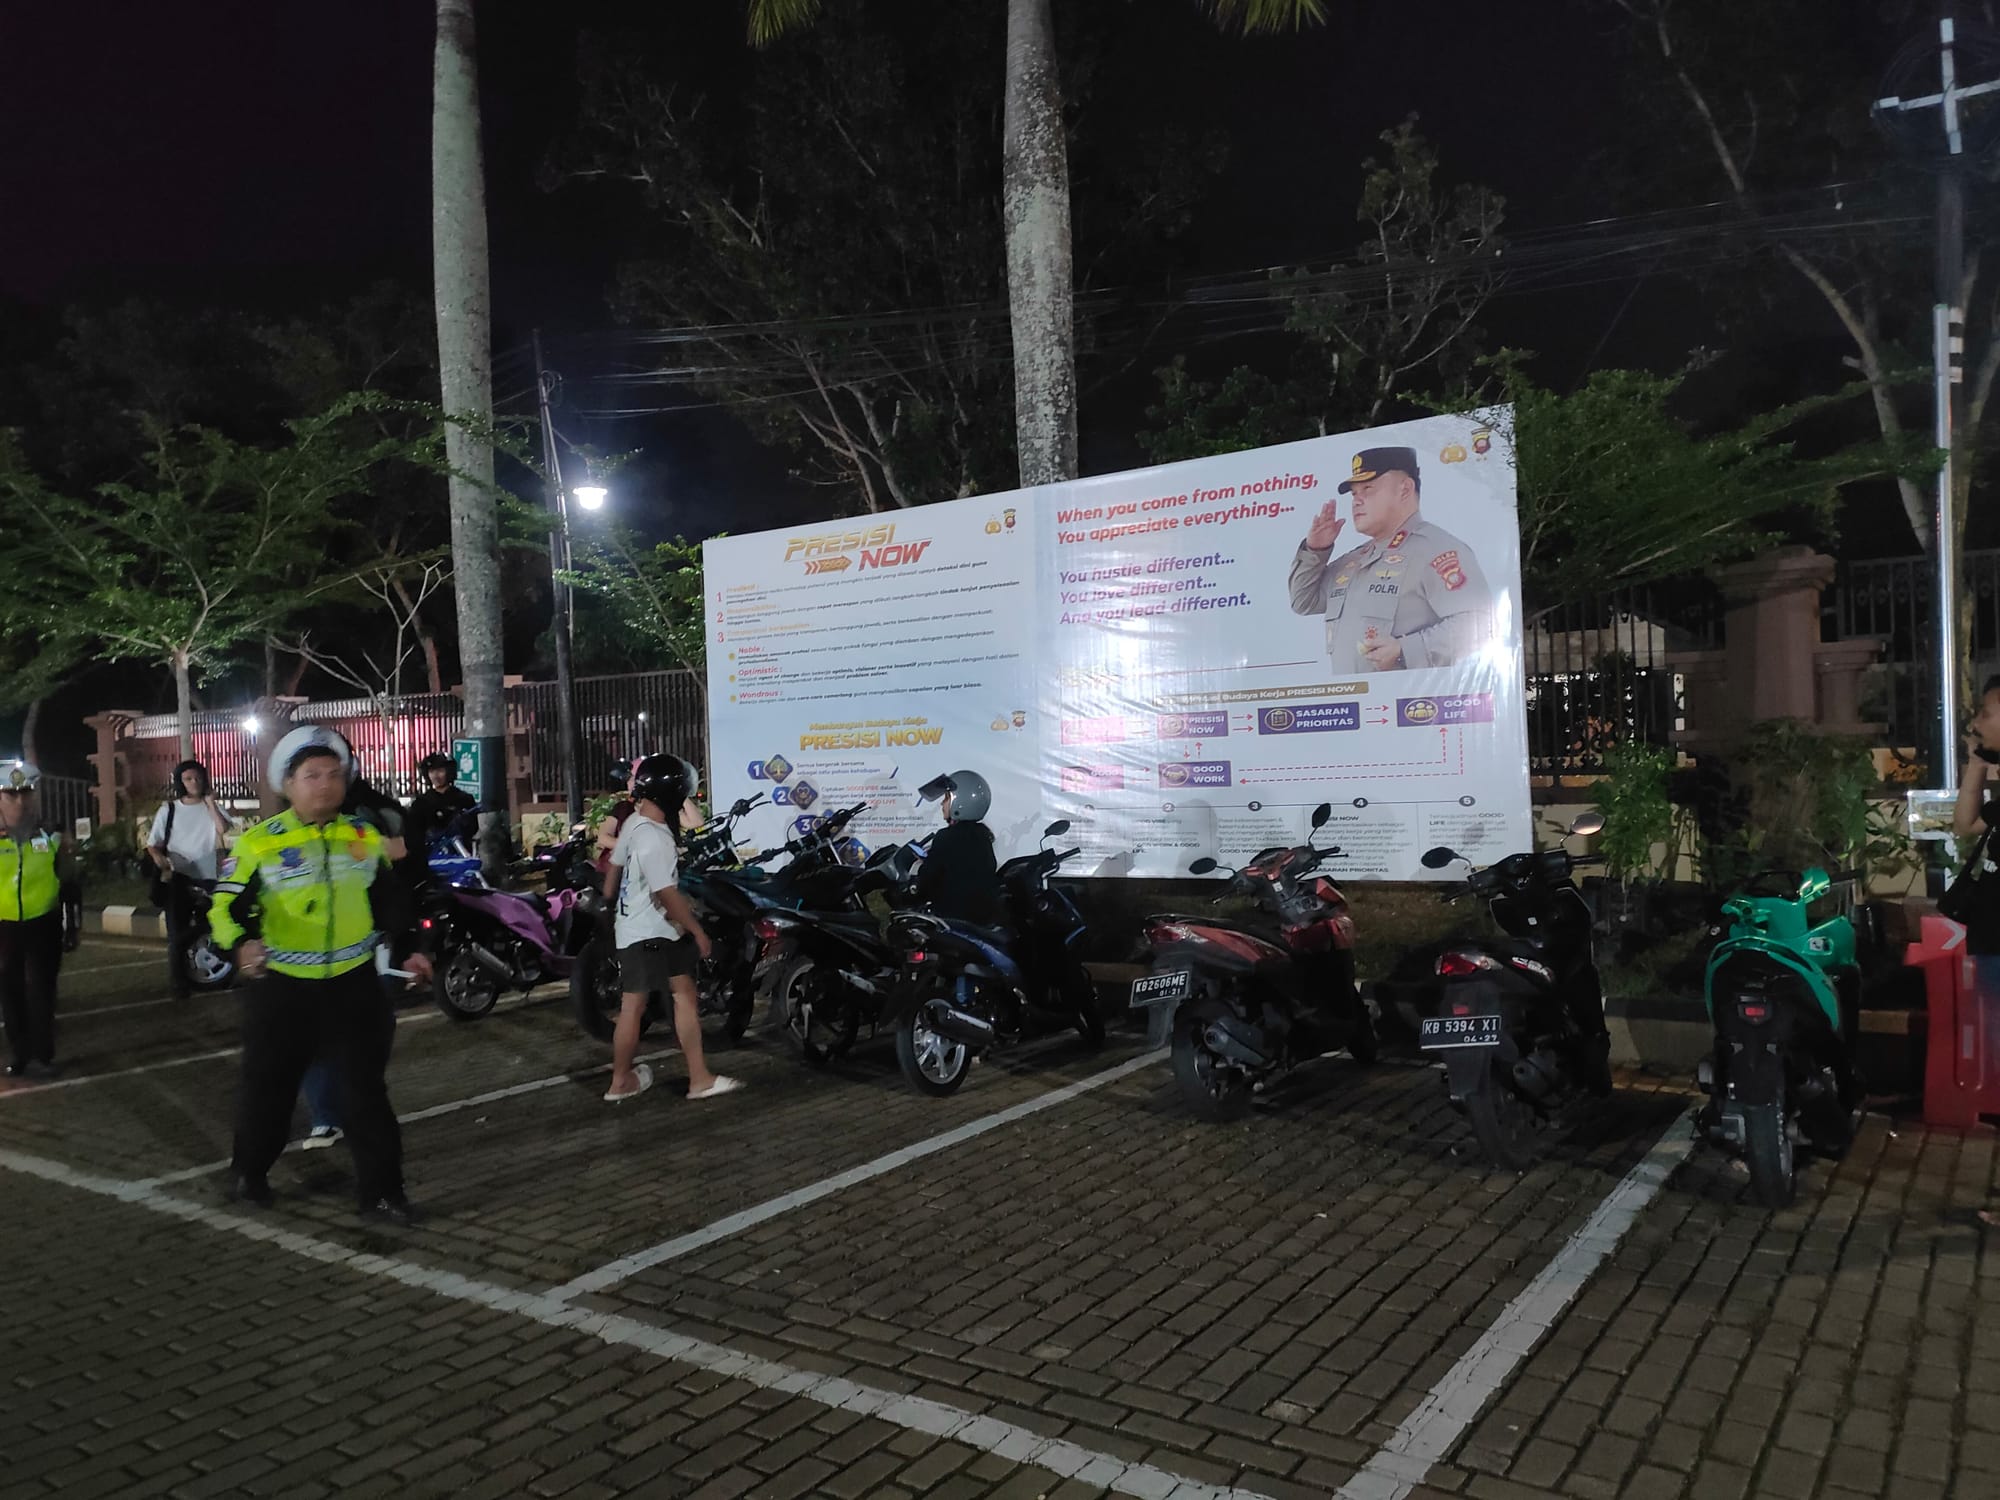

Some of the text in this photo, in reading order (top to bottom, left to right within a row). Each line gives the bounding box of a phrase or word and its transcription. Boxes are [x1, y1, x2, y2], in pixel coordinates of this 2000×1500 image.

[1057, 472, 1319, 524] When you come from nothing,
[1057, 499, 1295, 545] You appreciate everything...
[784, 523, 896, 562] PRESISI
[858, 540, 932, 571] NOW
[1059, 571, 1087, 585] You
[1146, 552, 1235, 574] different...
[1368, 584, 1399, 594] POLRI
[1060, 591, 1089, 605] You
[1059, 612, 1091, 625] And
[1171, 592, 1251, 613] different.
[1260, 689, 1285, 698] Kerja
[1287, 687, 1325, 696] PRESISI
[1327, 685, 1356, 693] NOW
[1443, 698, 1481, 708] GOOD
[1296, 707, 1349, 717] SASARAN
[1444, 711, 1467, 719] LIFE
[1188, 715, 1225, 723] PRESISI
[1296, 718, 1354, 728] PRIORITAS
[1188, 726, 1215, 734] NOW
[800, 727, 944, 750] PRESISI NOW
[753, 765, 760, 777] 1
[1193, 765, 1224, 773] GOOD
[1193, 775, 1225, 783] WORK
[777, 790, 786, 803] 2
[802, 819, 811, 831] 3
[1425, 1019, 1497, 1034] KB 5394 XI
